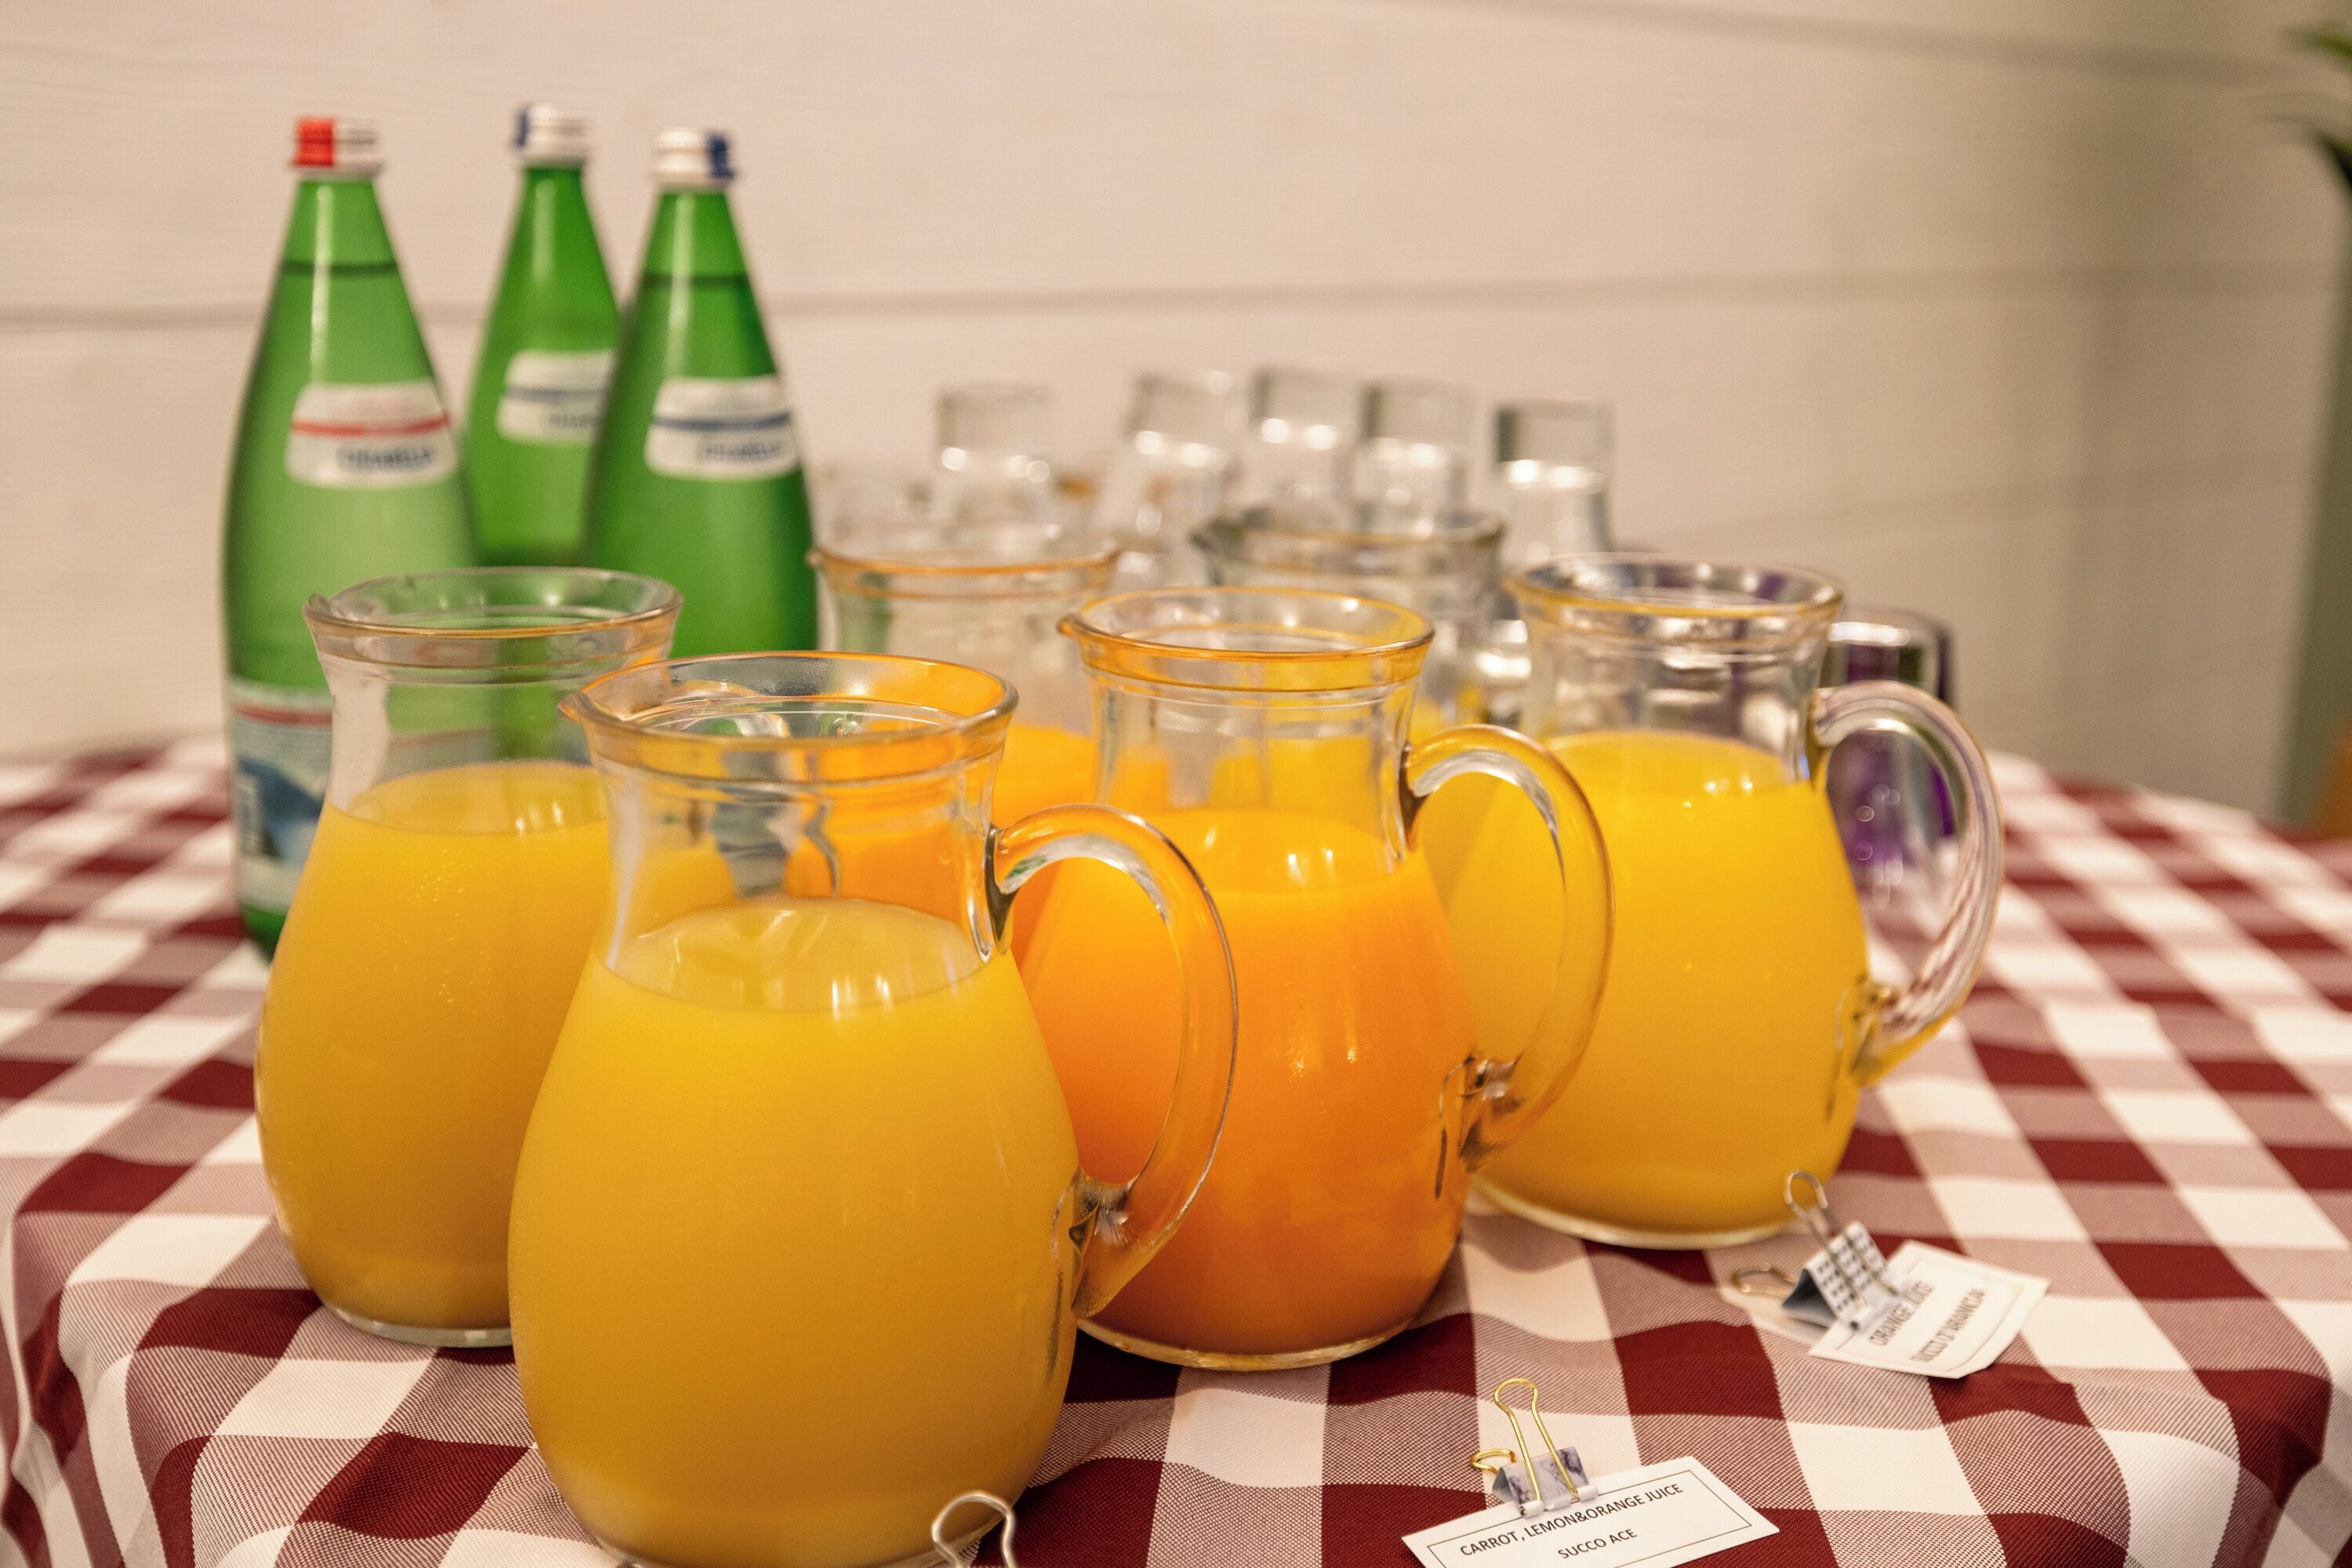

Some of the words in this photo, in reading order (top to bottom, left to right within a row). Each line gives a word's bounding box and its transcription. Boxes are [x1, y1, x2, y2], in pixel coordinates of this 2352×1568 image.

[1869, 1305, 1915, 1345] ORANGE
[1460, 1531, 1525, 1555] CARROT,
[1524, 1494, 1644, 1537] LEMON&ORANGE
[1645, 1483, 1683, 1501] JUICE
[1558, 1537, 1606, 1559] SUCCO
[1610, 1529, 1638, 1544] ACE
